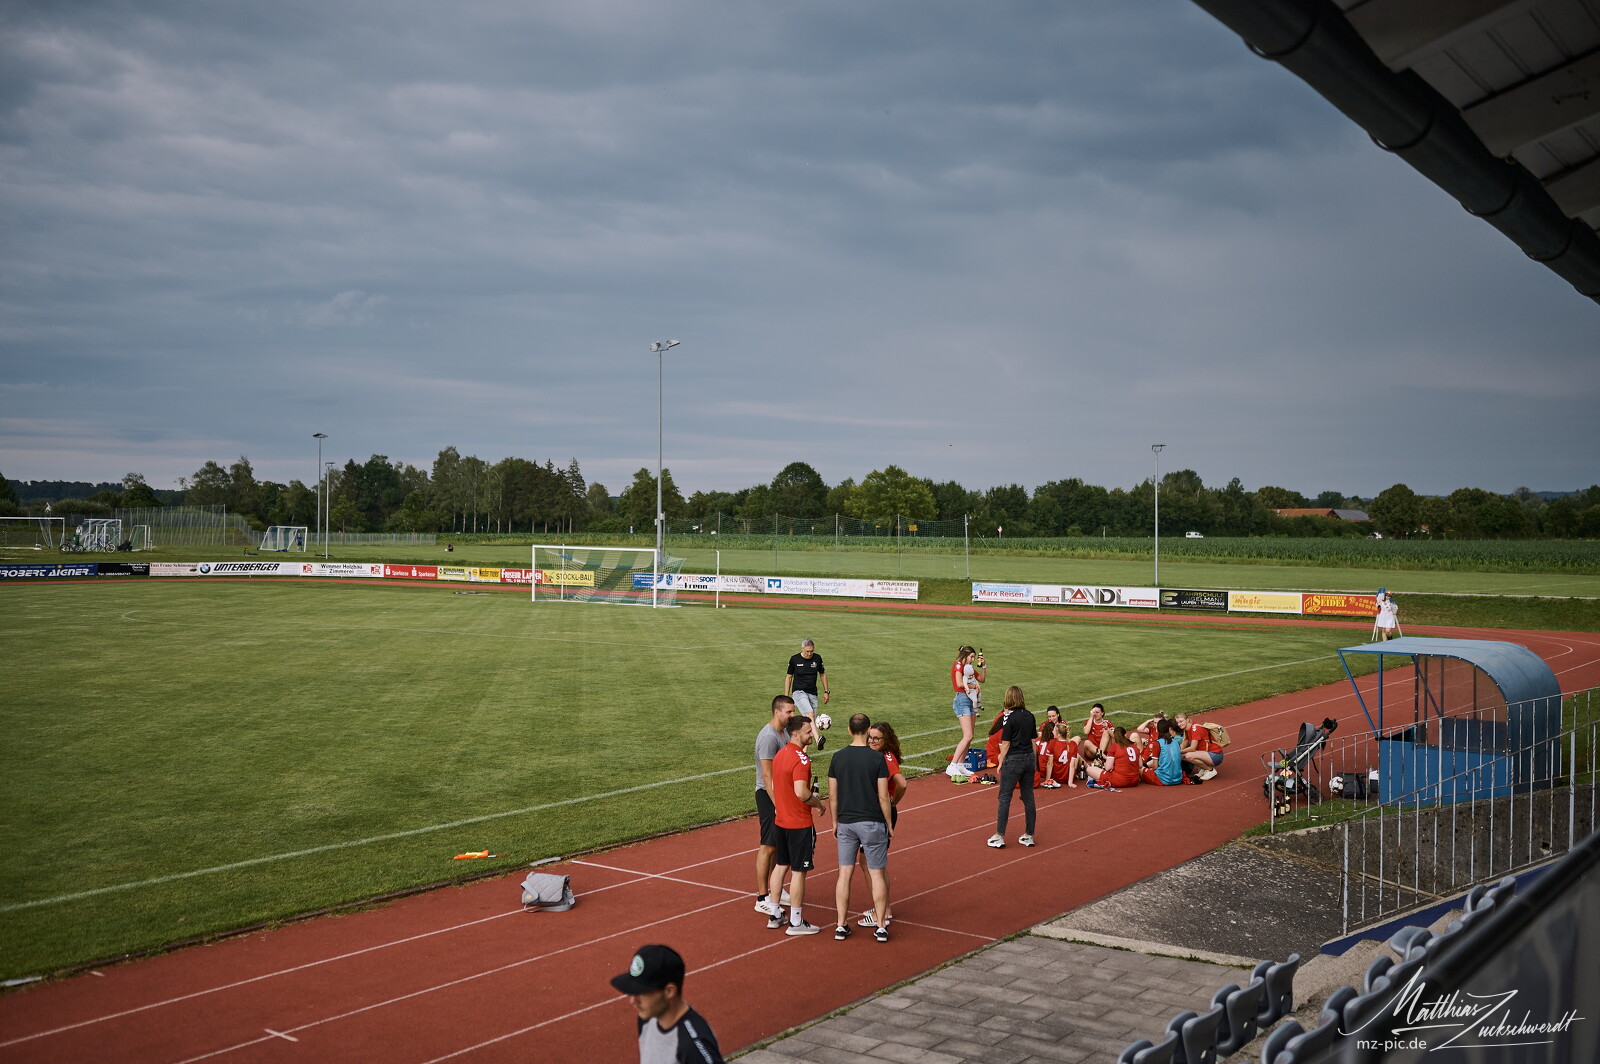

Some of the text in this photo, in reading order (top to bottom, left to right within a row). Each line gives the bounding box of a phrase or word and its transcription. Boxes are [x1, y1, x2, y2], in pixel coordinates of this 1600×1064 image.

[48, 568, 90, 576] AIGNER
[214, 563, 280, 571] UNTERBERGER
[522, 570, 542, 580] LAPER
[1235, 596, 1260, 605] music
[1313, 595, 1347, 607] SEIDEL
[1059, 750, 1068, 764] 4
[1126, 746, 1136, 762] 9
